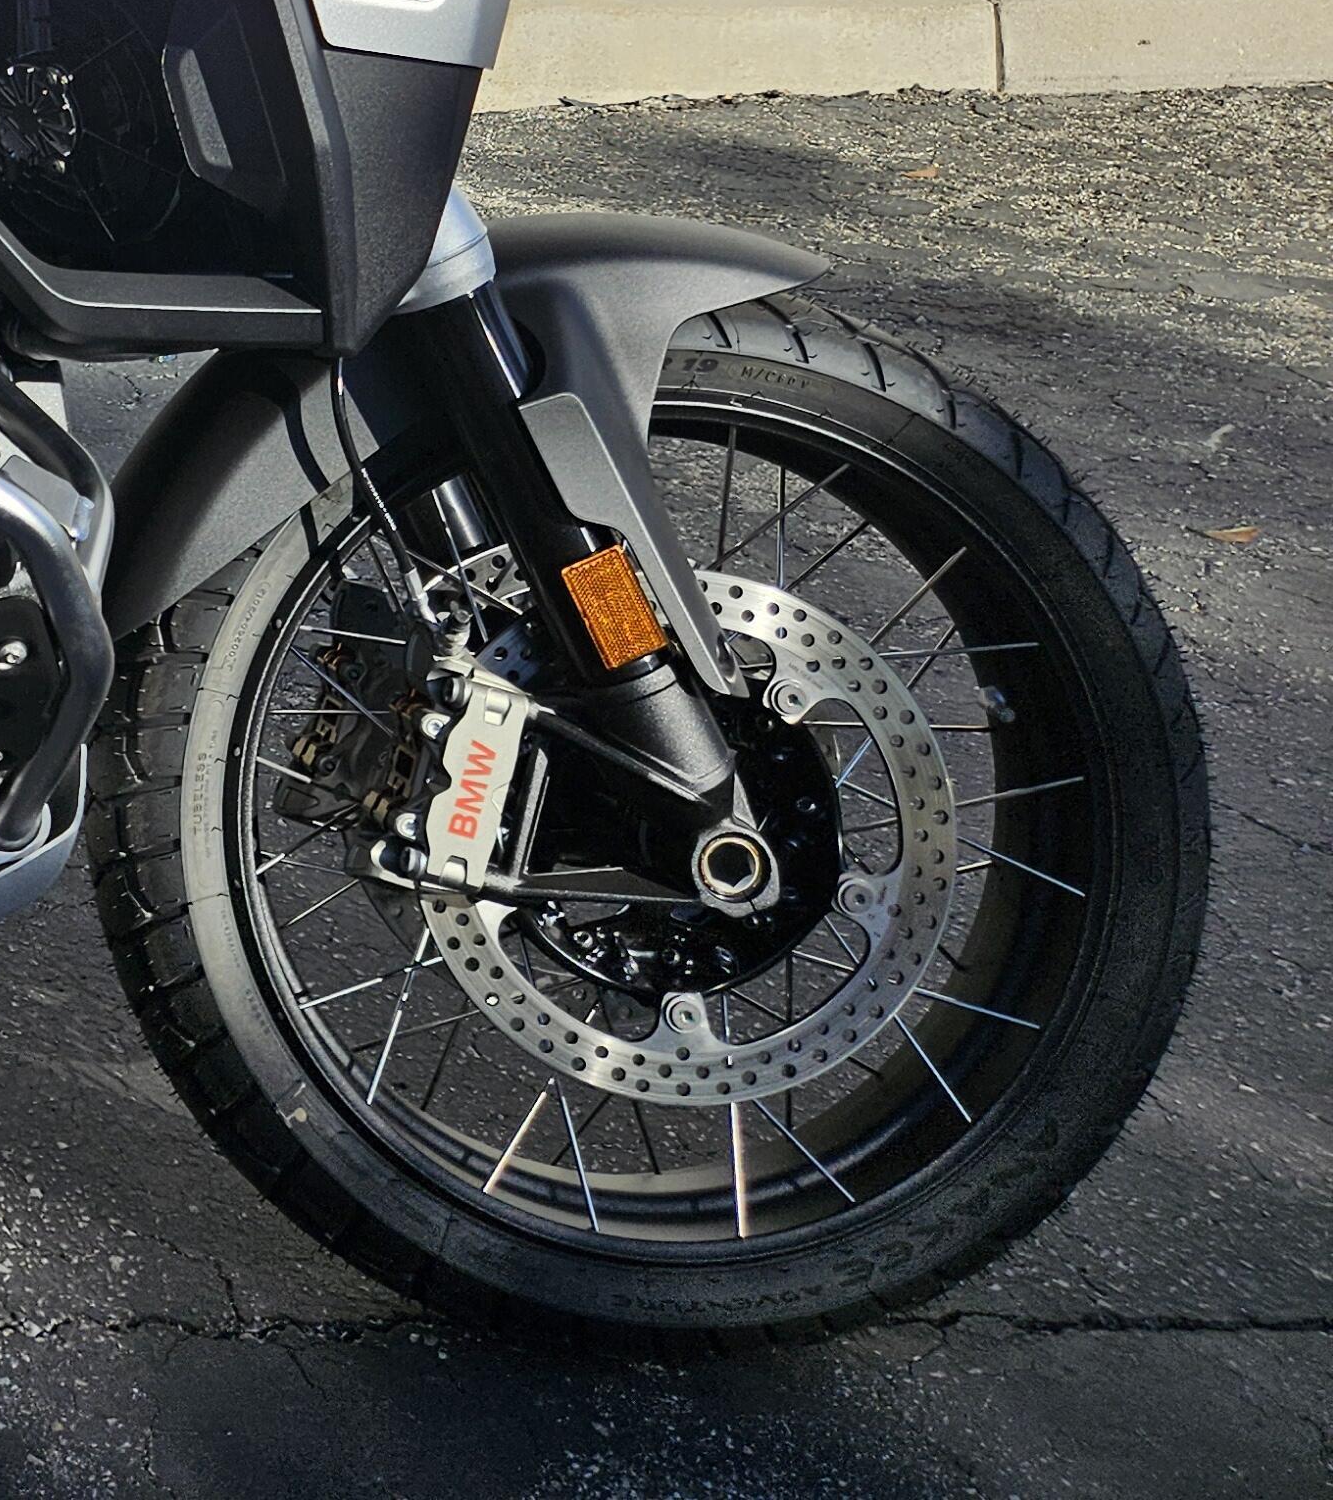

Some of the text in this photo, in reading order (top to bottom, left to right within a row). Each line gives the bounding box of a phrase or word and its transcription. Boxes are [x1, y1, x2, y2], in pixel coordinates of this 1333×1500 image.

[682, 356, 718, 373] 19
[193, 752, 207, 835] TUBELESS
[448, 740, 497, 840] BMW
